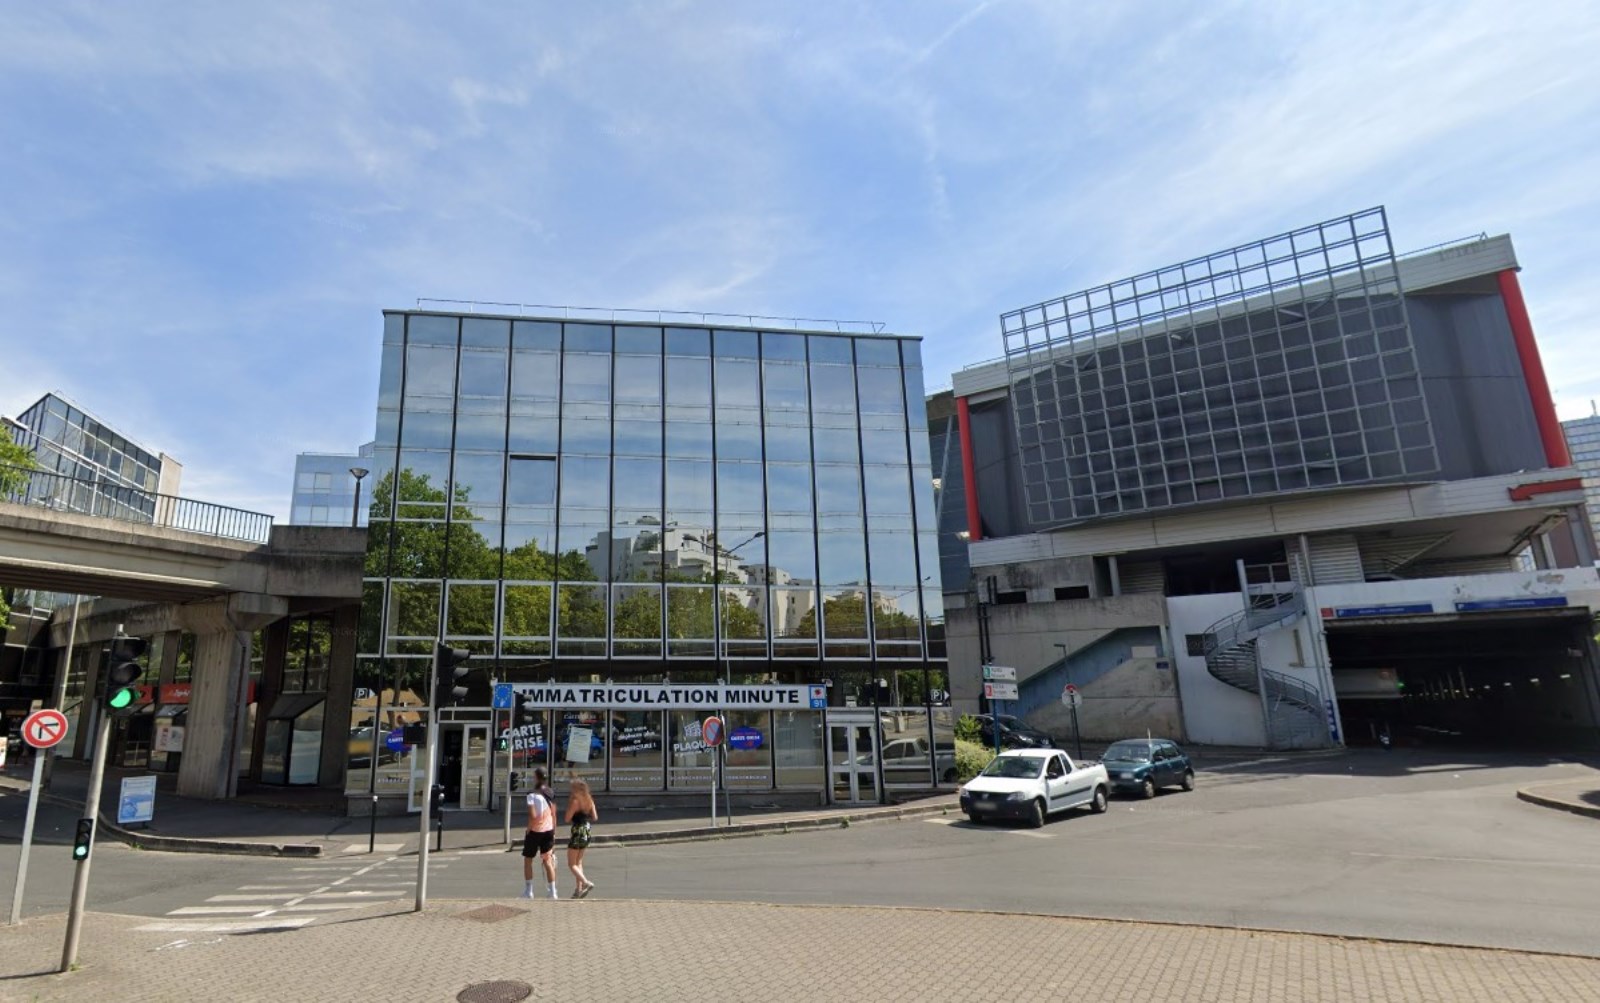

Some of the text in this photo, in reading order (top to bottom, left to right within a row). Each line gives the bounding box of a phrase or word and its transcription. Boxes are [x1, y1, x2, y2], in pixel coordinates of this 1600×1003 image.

[725, 689, 799, 703] MINUTE
[813, 699, 823, 708] 91
[501, 723, 542, 739] CARTE
[508, 735, 544, 751] RISE
[673, 740, 712, 752] PLAQU
